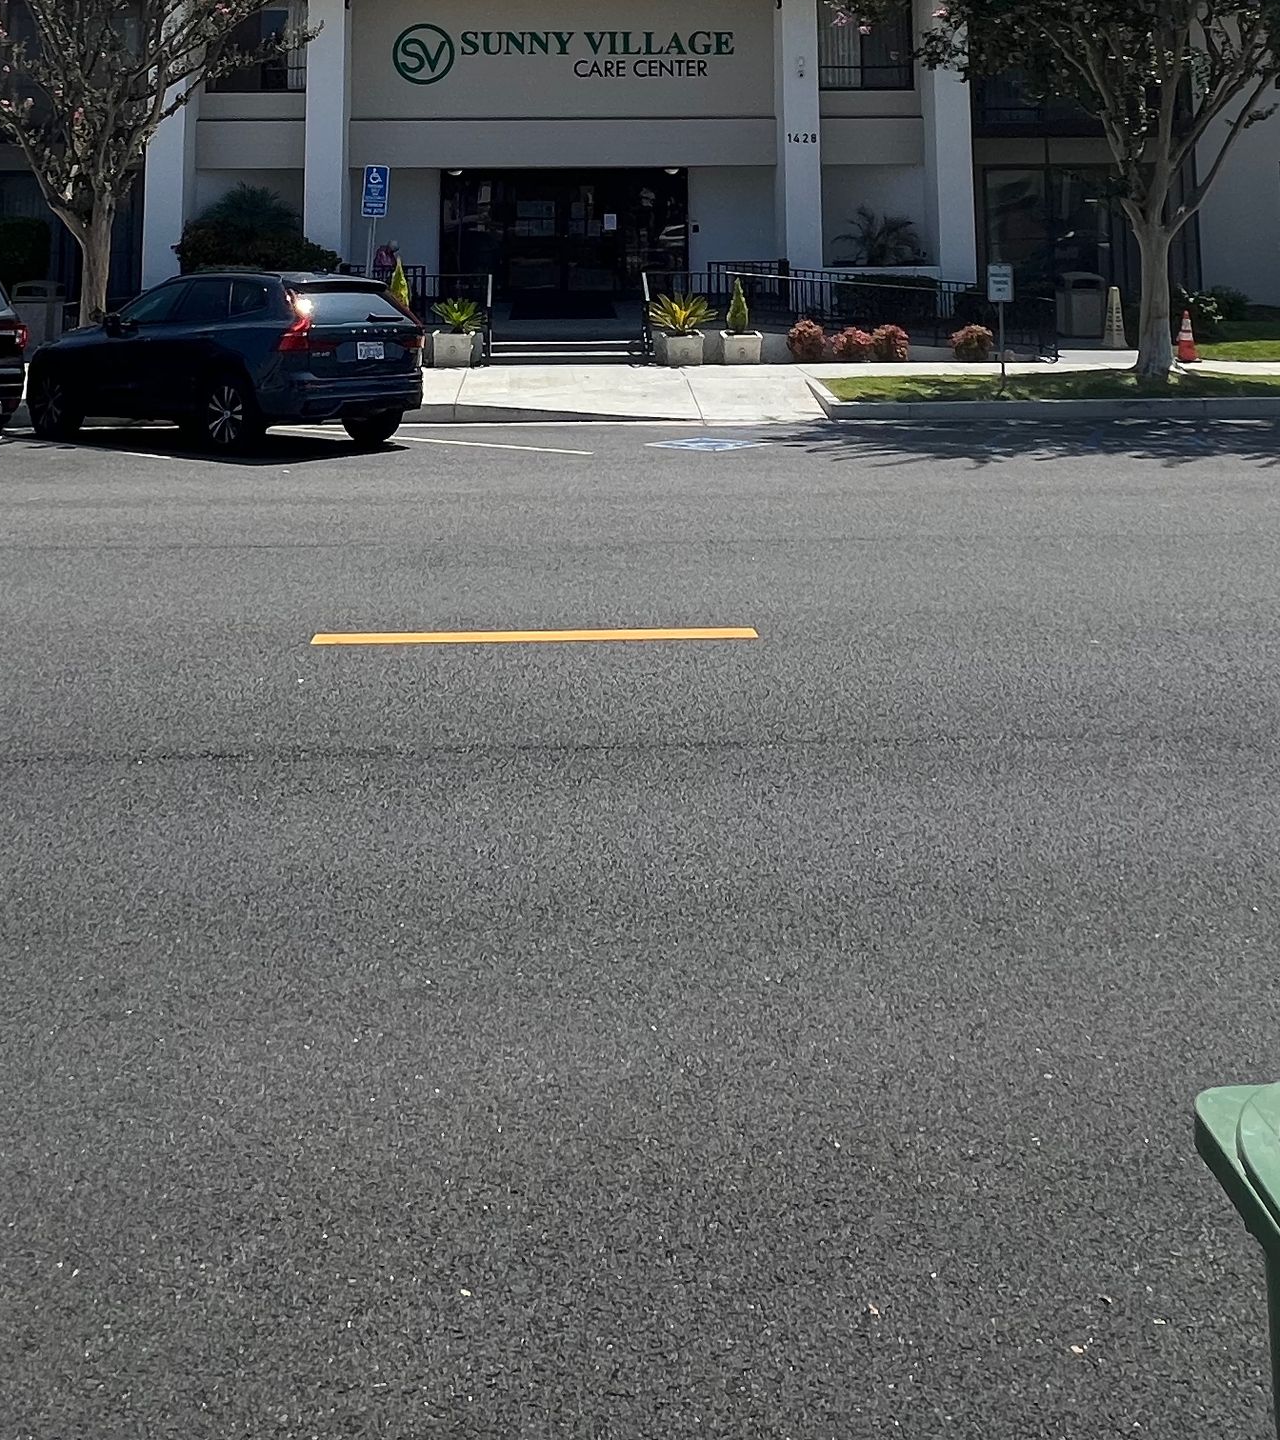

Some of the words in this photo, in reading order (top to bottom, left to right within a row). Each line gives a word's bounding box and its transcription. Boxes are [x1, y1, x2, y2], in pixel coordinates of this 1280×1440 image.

[460, 31, 574, 56] SUNNY
[584, 31, 735, 56] VILLAGE
[398, 36, 448, 75] SV
[573, 59, 626, 78] CARE
[632, 59, 708, 78] CENTER
[787, 133, 817, 143] 1428
